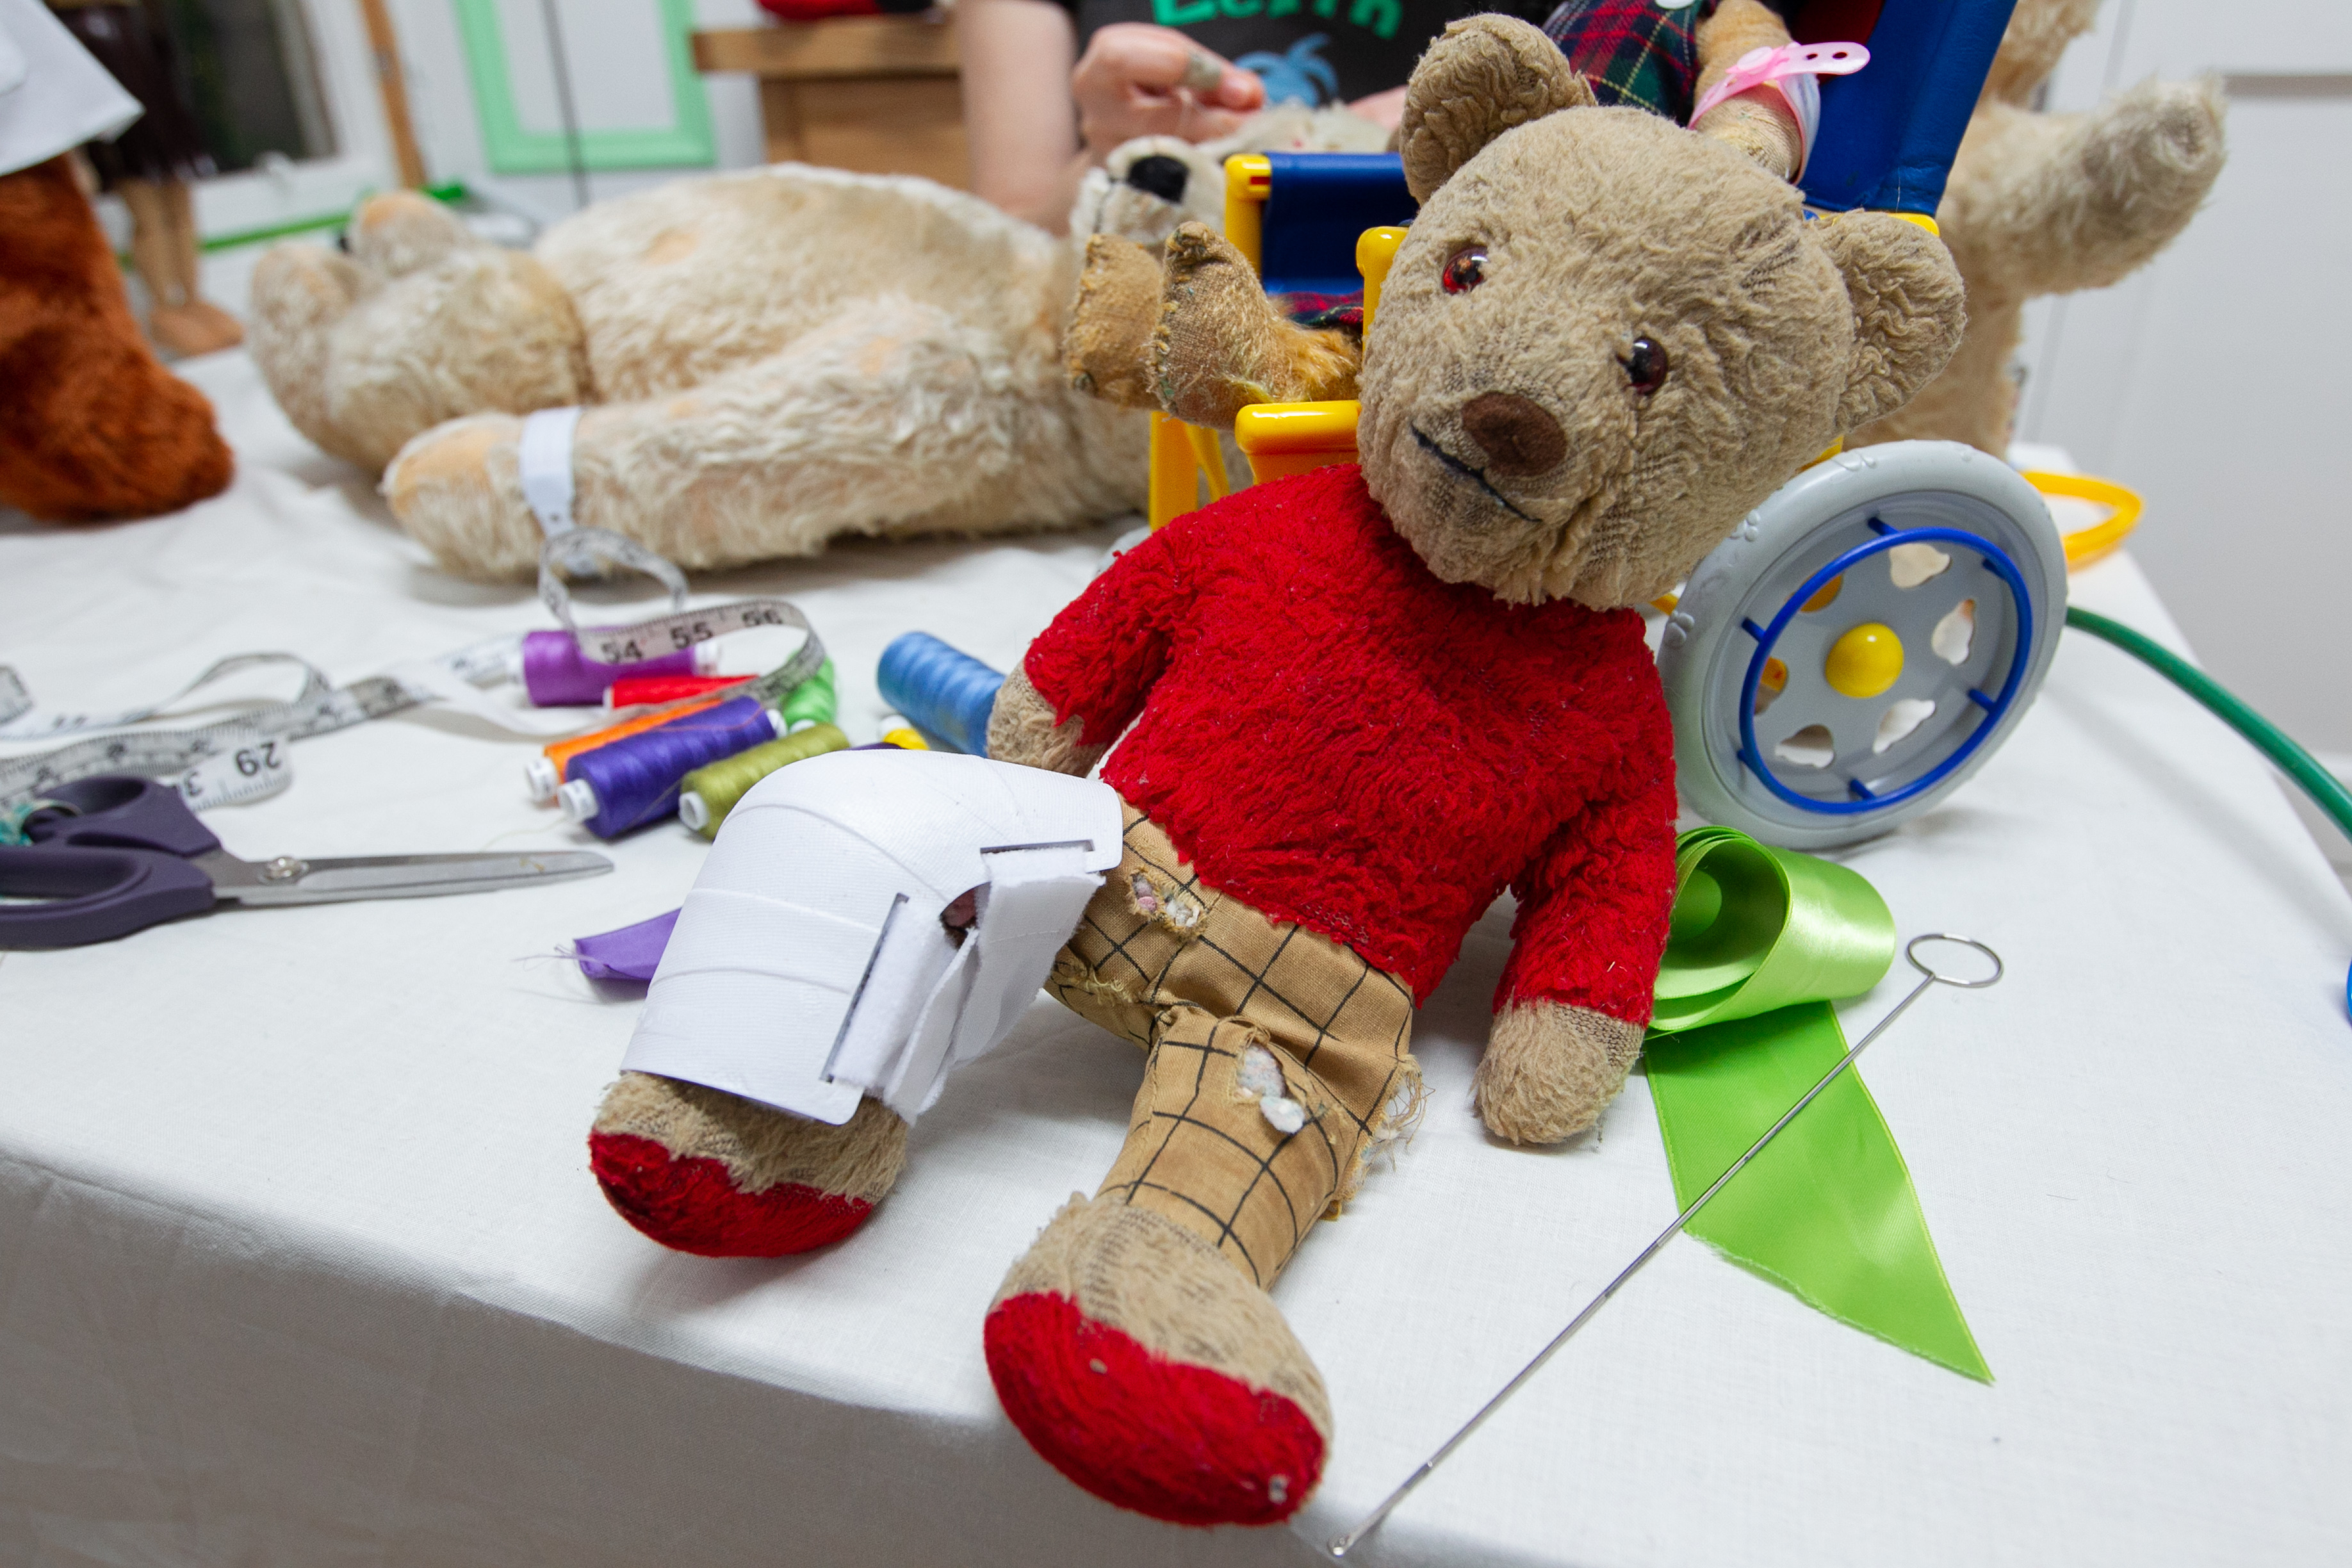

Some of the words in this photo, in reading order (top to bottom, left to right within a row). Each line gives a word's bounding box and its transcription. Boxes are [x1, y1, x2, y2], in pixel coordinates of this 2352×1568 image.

[601, 641, 643, 664] 54
[671, 621, 714, 649] 55
[234, 741, 282, 777] 29
[184, 771, 204, 797] 3
